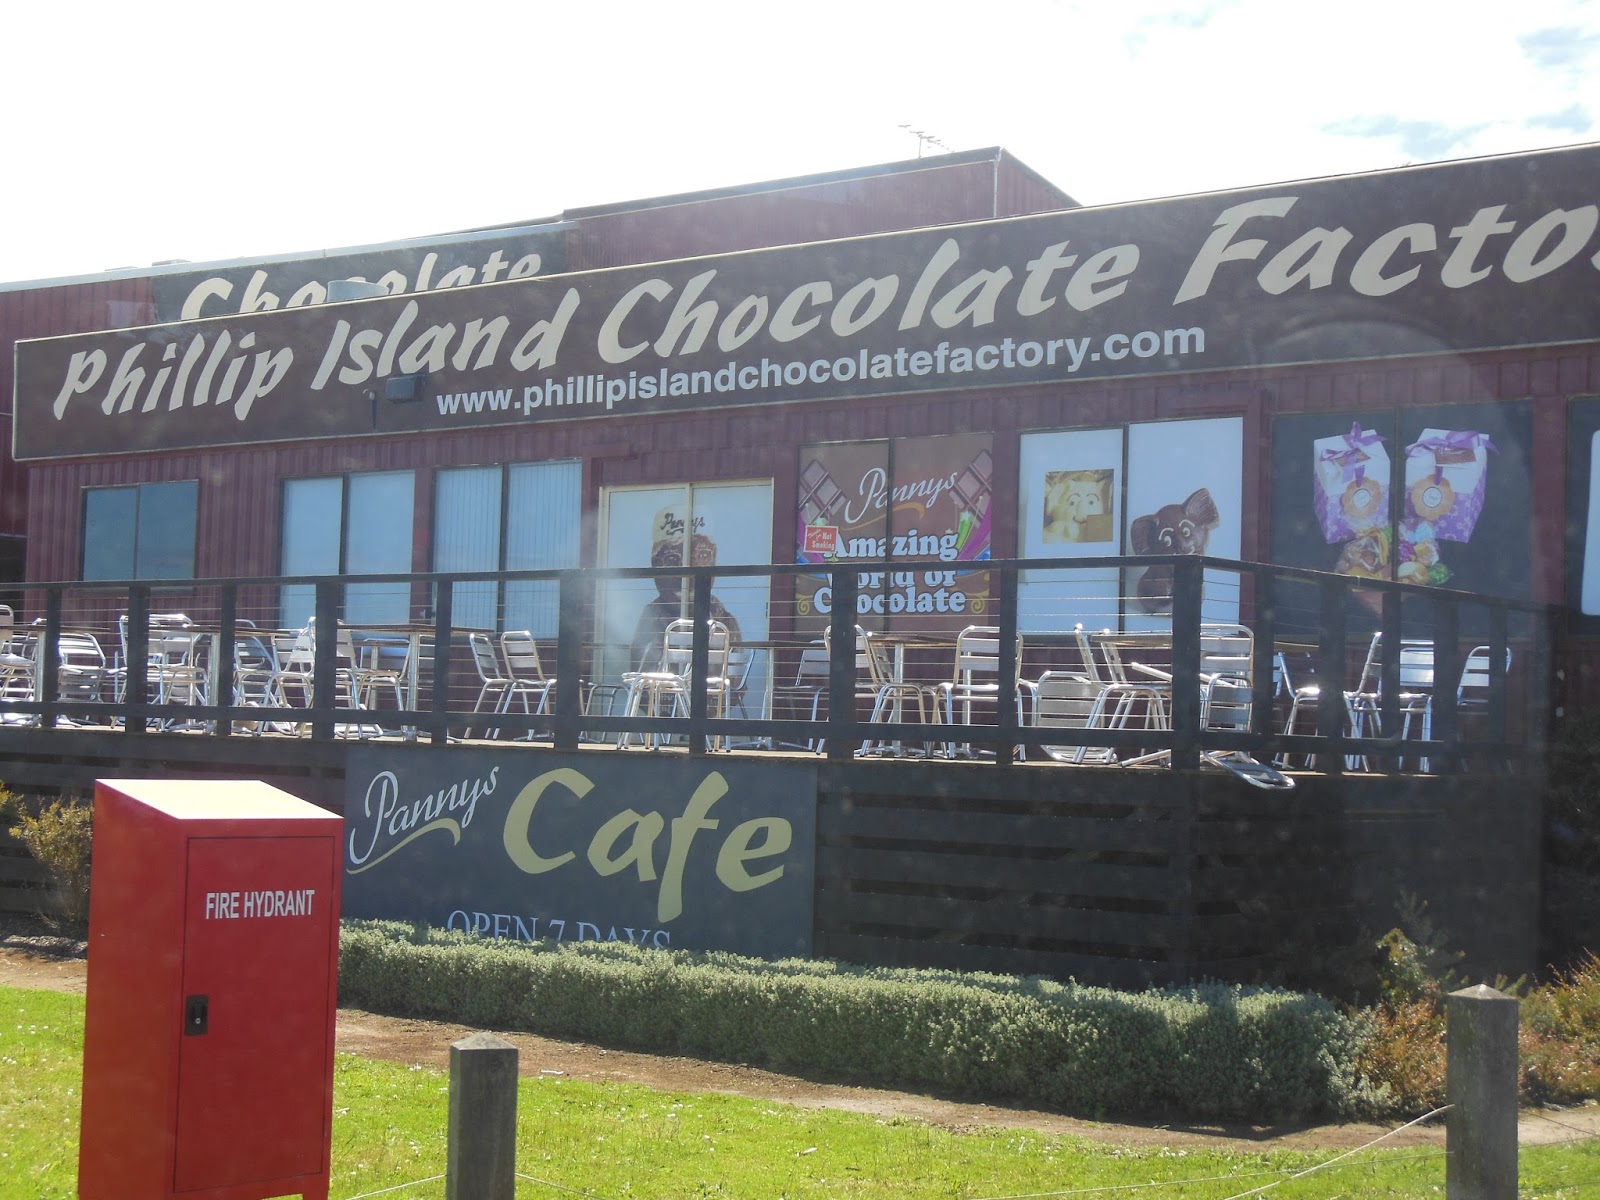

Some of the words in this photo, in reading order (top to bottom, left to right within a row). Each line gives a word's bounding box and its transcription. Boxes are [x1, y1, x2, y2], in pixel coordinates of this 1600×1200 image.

[53, 330, 293, 420] Phillip
[310, 288, 580, 391] Island
[597, 238, 1140, 364] Chocolate
[1172, 196, 1600, 305] Facto
[181, 250, 542, 320] Choolate
[436, 326, 1206, 412] www.phillipislandchocolatefactory.com
[844, 467, 958, 524] Pannys
[813, 585, 966, 614] Cocolate
[349, 766, 500, 865] Pannys
[503, 767, 793, 923] Cafe
[205, 892, 240, 919] FIRE
[243, 890, 315, 918] HYDRANT
[447, 910, 539, 942] OPEN
[549, 919, 566, 941] 7
